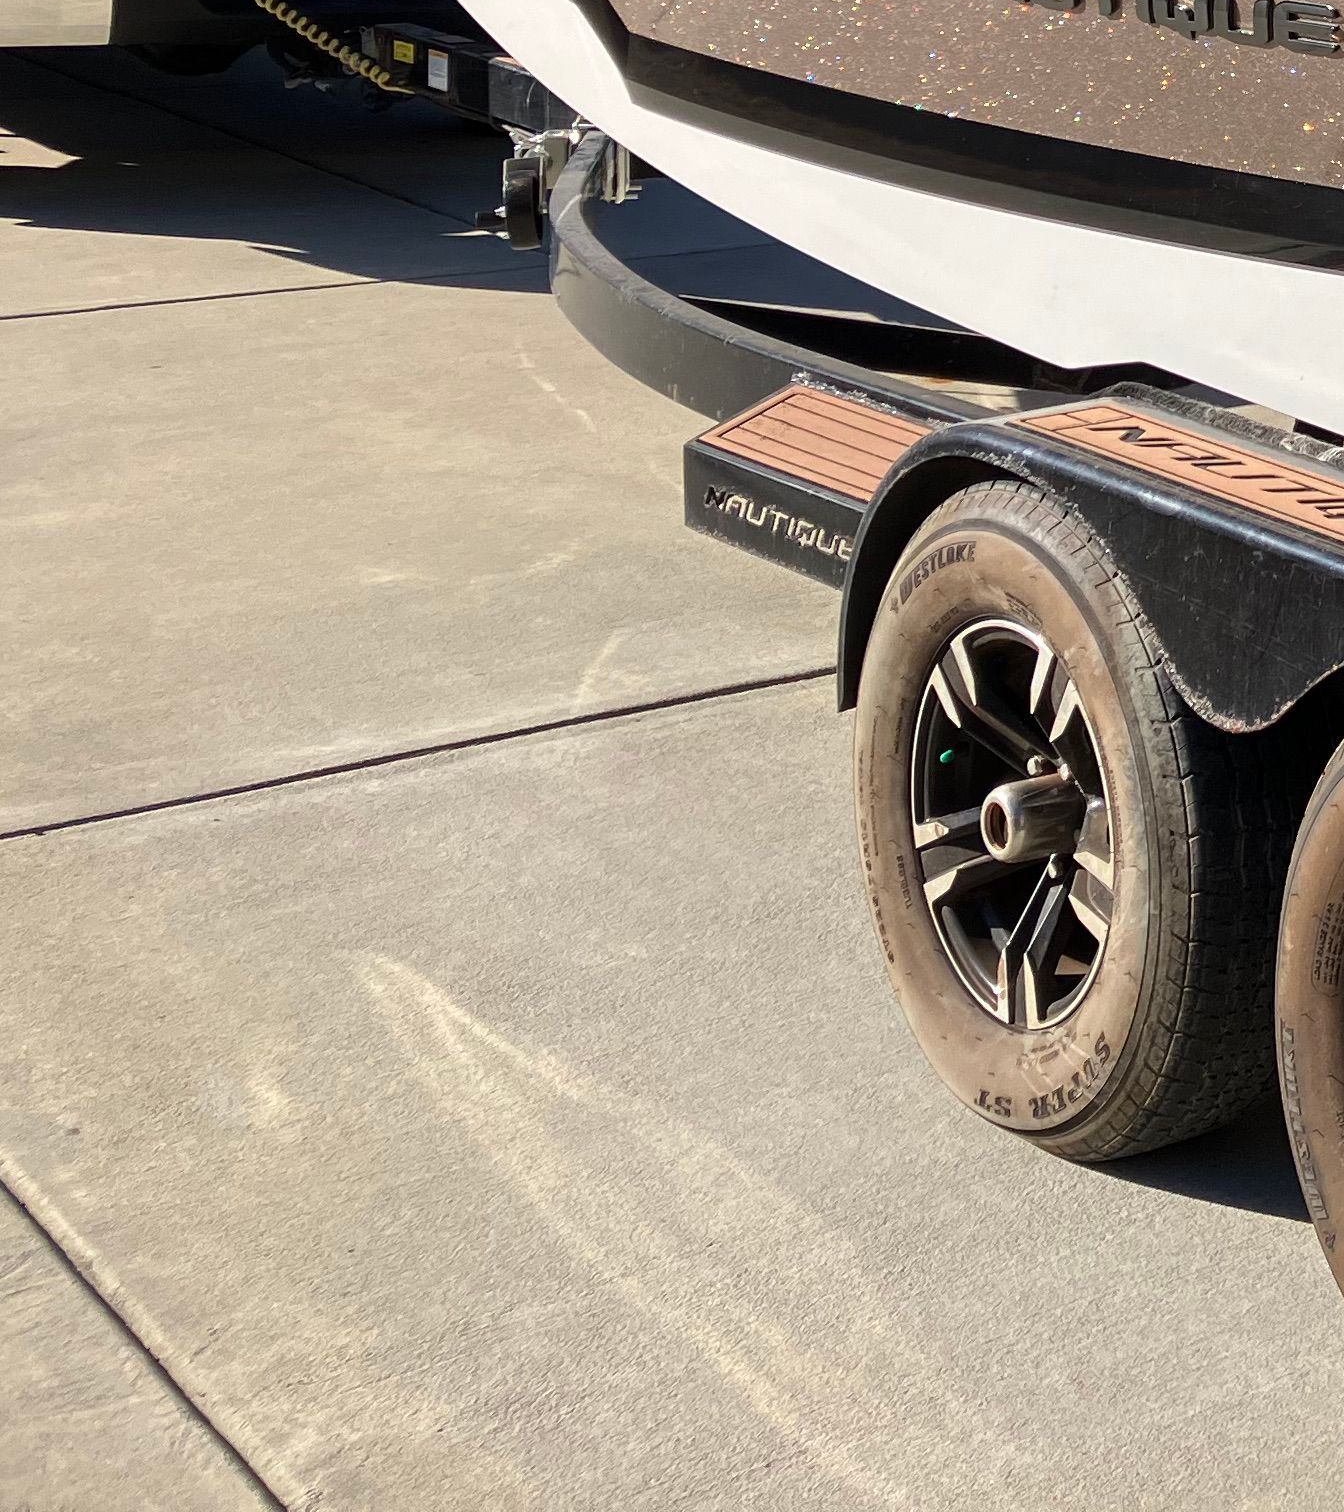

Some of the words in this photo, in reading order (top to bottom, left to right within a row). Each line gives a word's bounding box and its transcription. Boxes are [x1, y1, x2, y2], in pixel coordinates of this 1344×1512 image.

[704, 485, 852, 561] NAUTIQUE
[900, 541, 977, 605] WESTLAKE
[974, 1088, 1012, 1118] ST
[1029, 1031, 1111, 1120] SUPER
